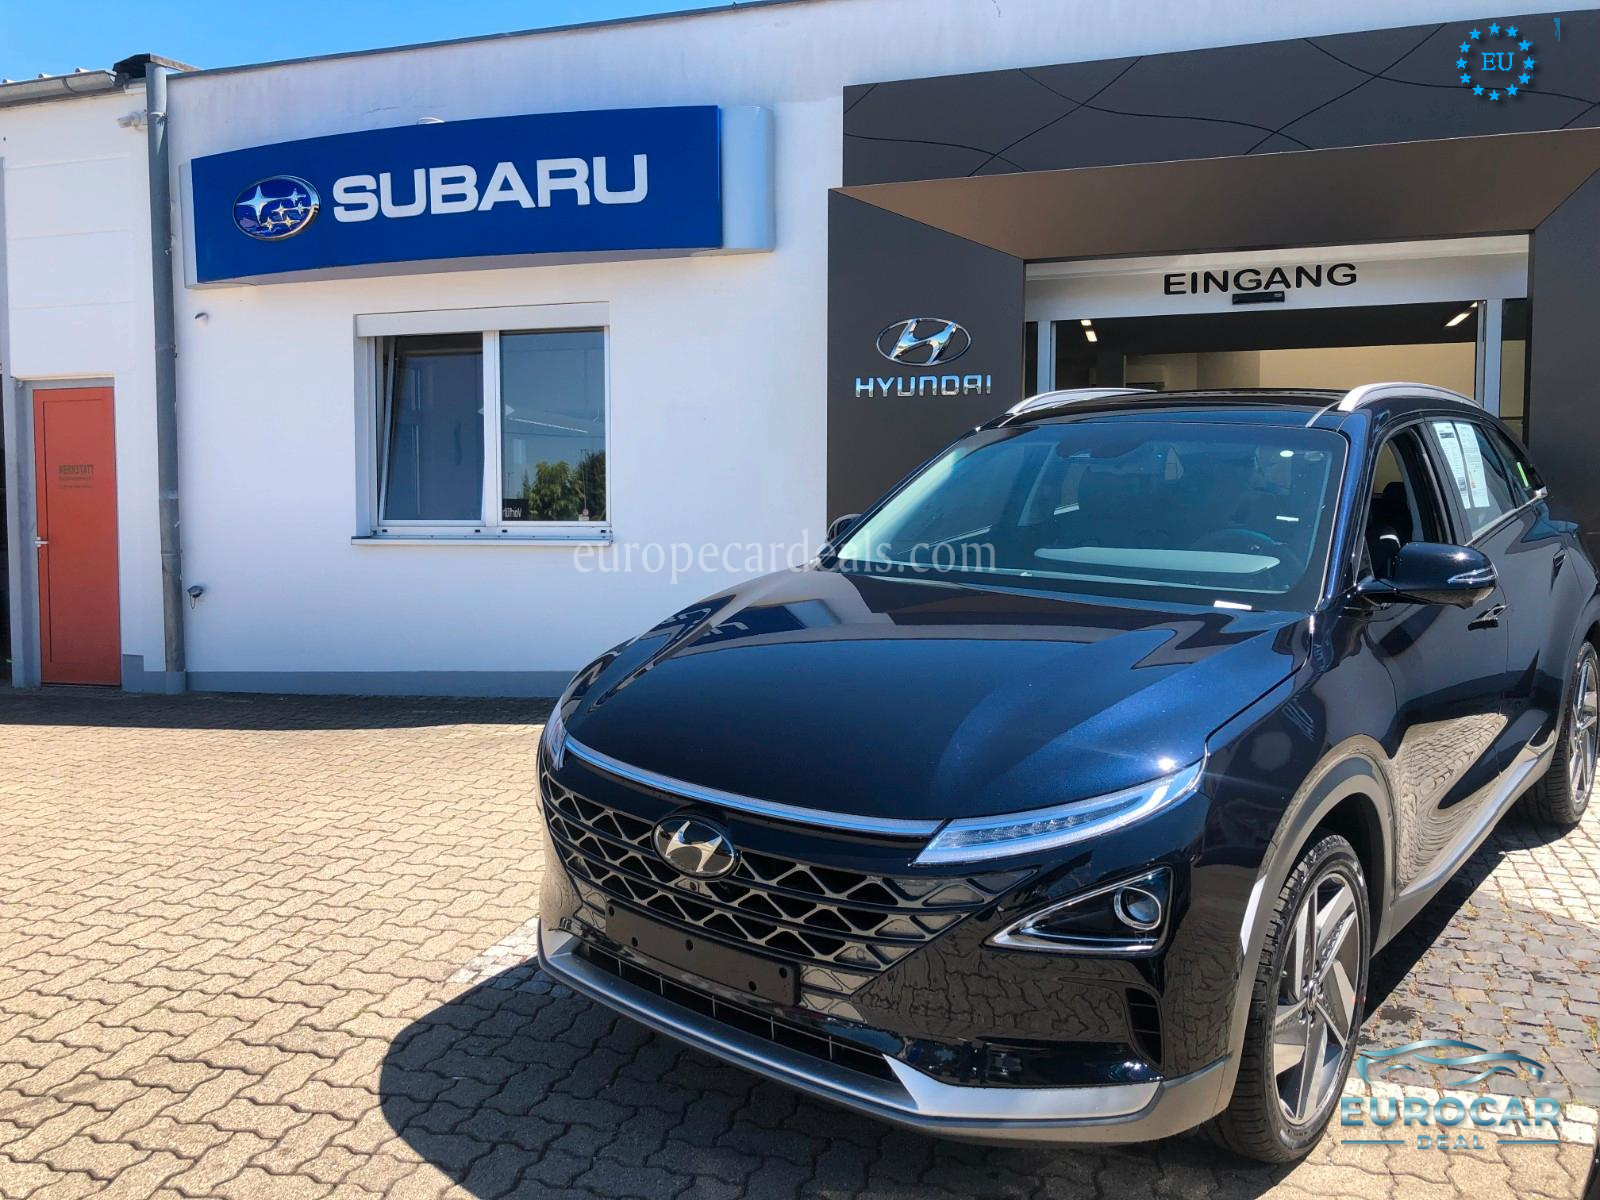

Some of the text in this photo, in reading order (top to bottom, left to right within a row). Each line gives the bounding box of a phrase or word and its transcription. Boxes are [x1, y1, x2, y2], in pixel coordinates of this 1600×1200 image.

[332, 153, 648, 223] SUBARU
[1163, 262, 1357, 296] EINGANG
[855, 374, 992, 398] HYUNDAI
